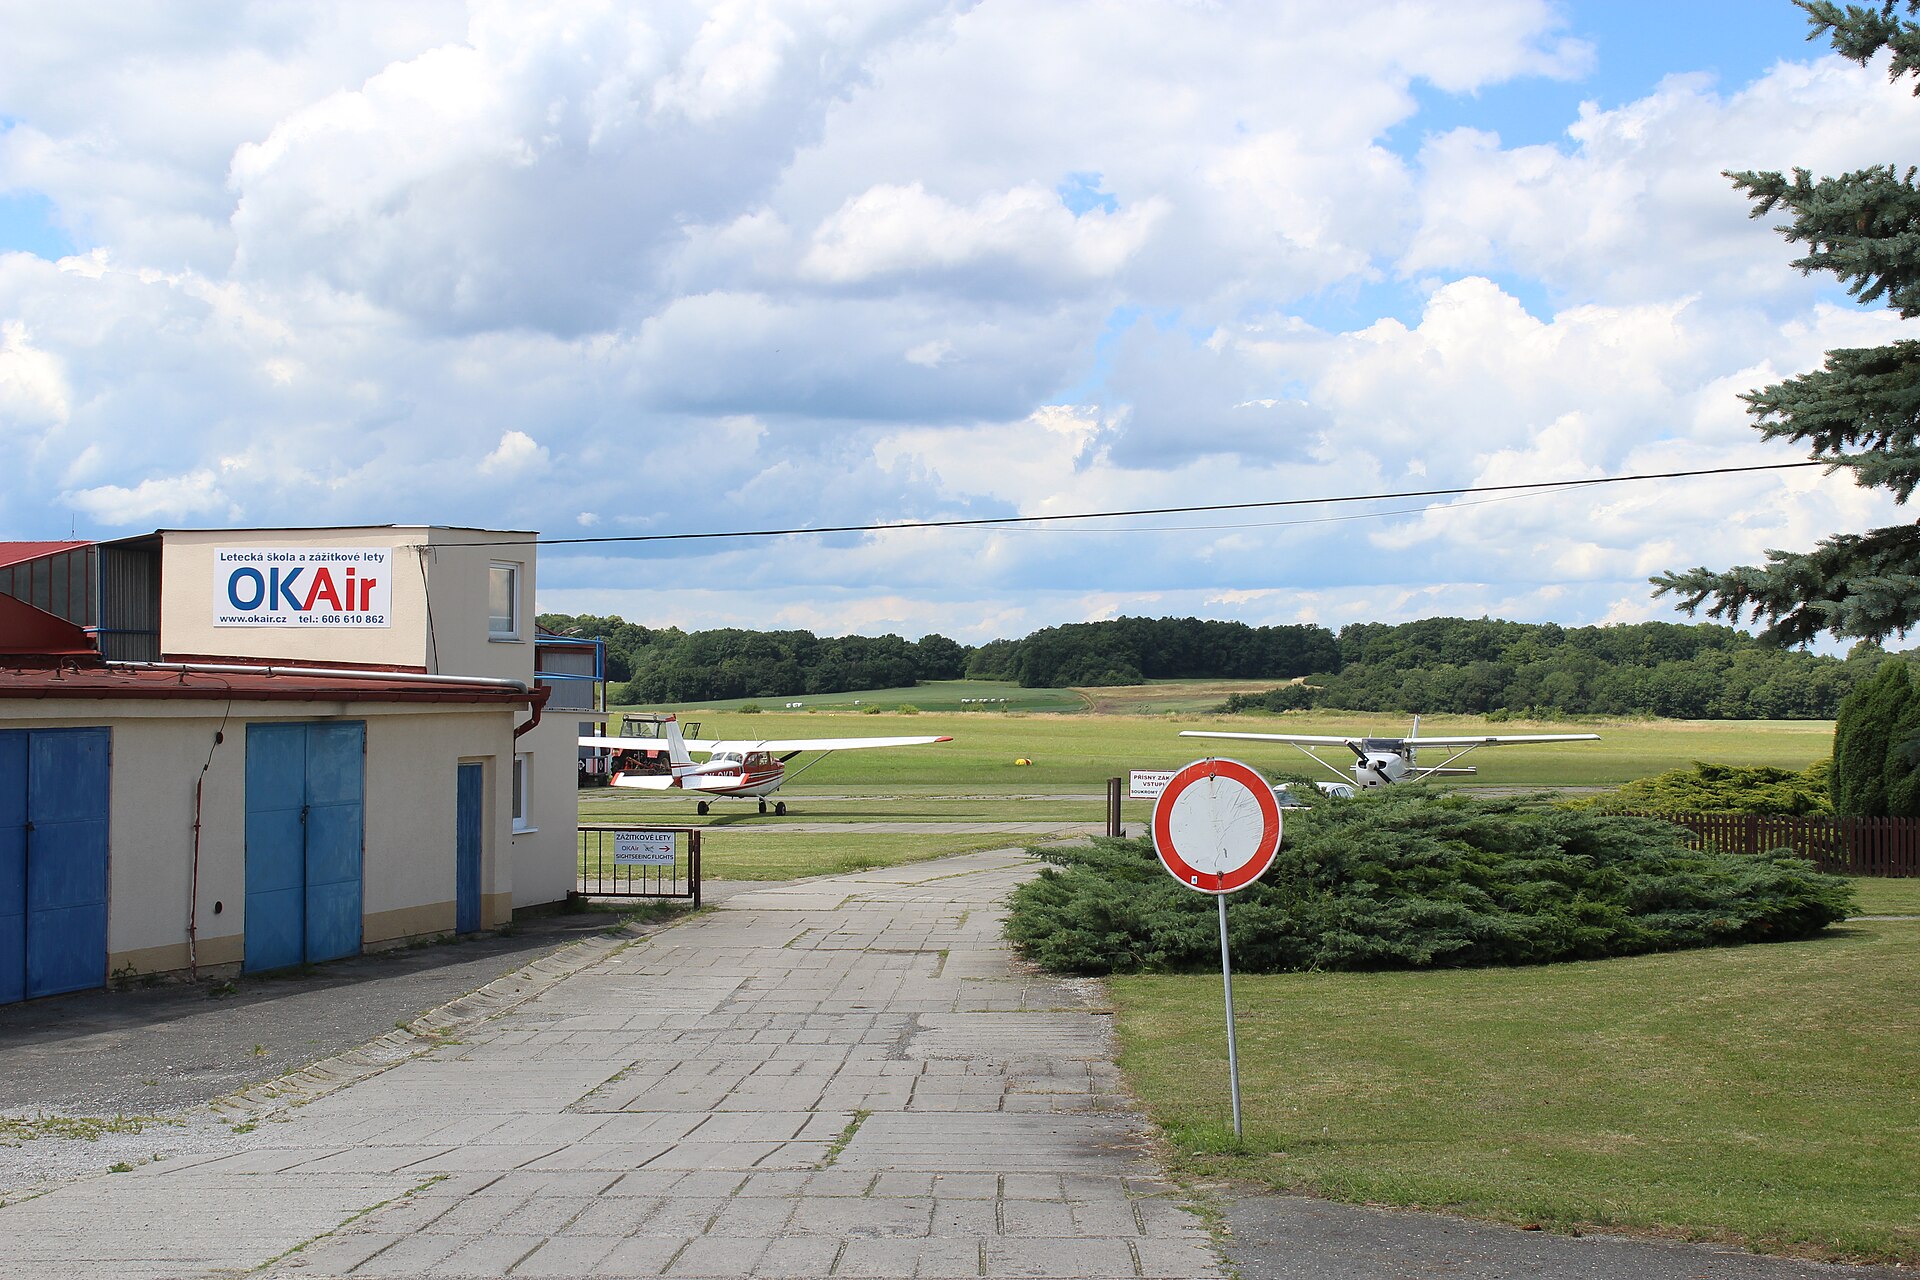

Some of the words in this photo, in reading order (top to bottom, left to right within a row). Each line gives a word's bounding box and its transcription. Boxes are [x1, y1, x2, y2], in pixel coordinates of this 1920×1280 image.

[220, 553, 264, 562] Letecká
[267, 553, 296, 562] škola
[299, 554, 306, 562] a
[309, 553, 361, 562] zážitkové
[364, 553, 385, 563] lety
[227, 567, 377, 611] OKAir
[219, 615, 288, 624] www.okair.cz
[299, 615, 319, 624] tel.:
[321, 615, 341, 624] 606
[343, 615, 362, 624] 610
[365, 615, 384, 624] 862
[616, 833, 654, 841] ZÁŽITKOVÉ
